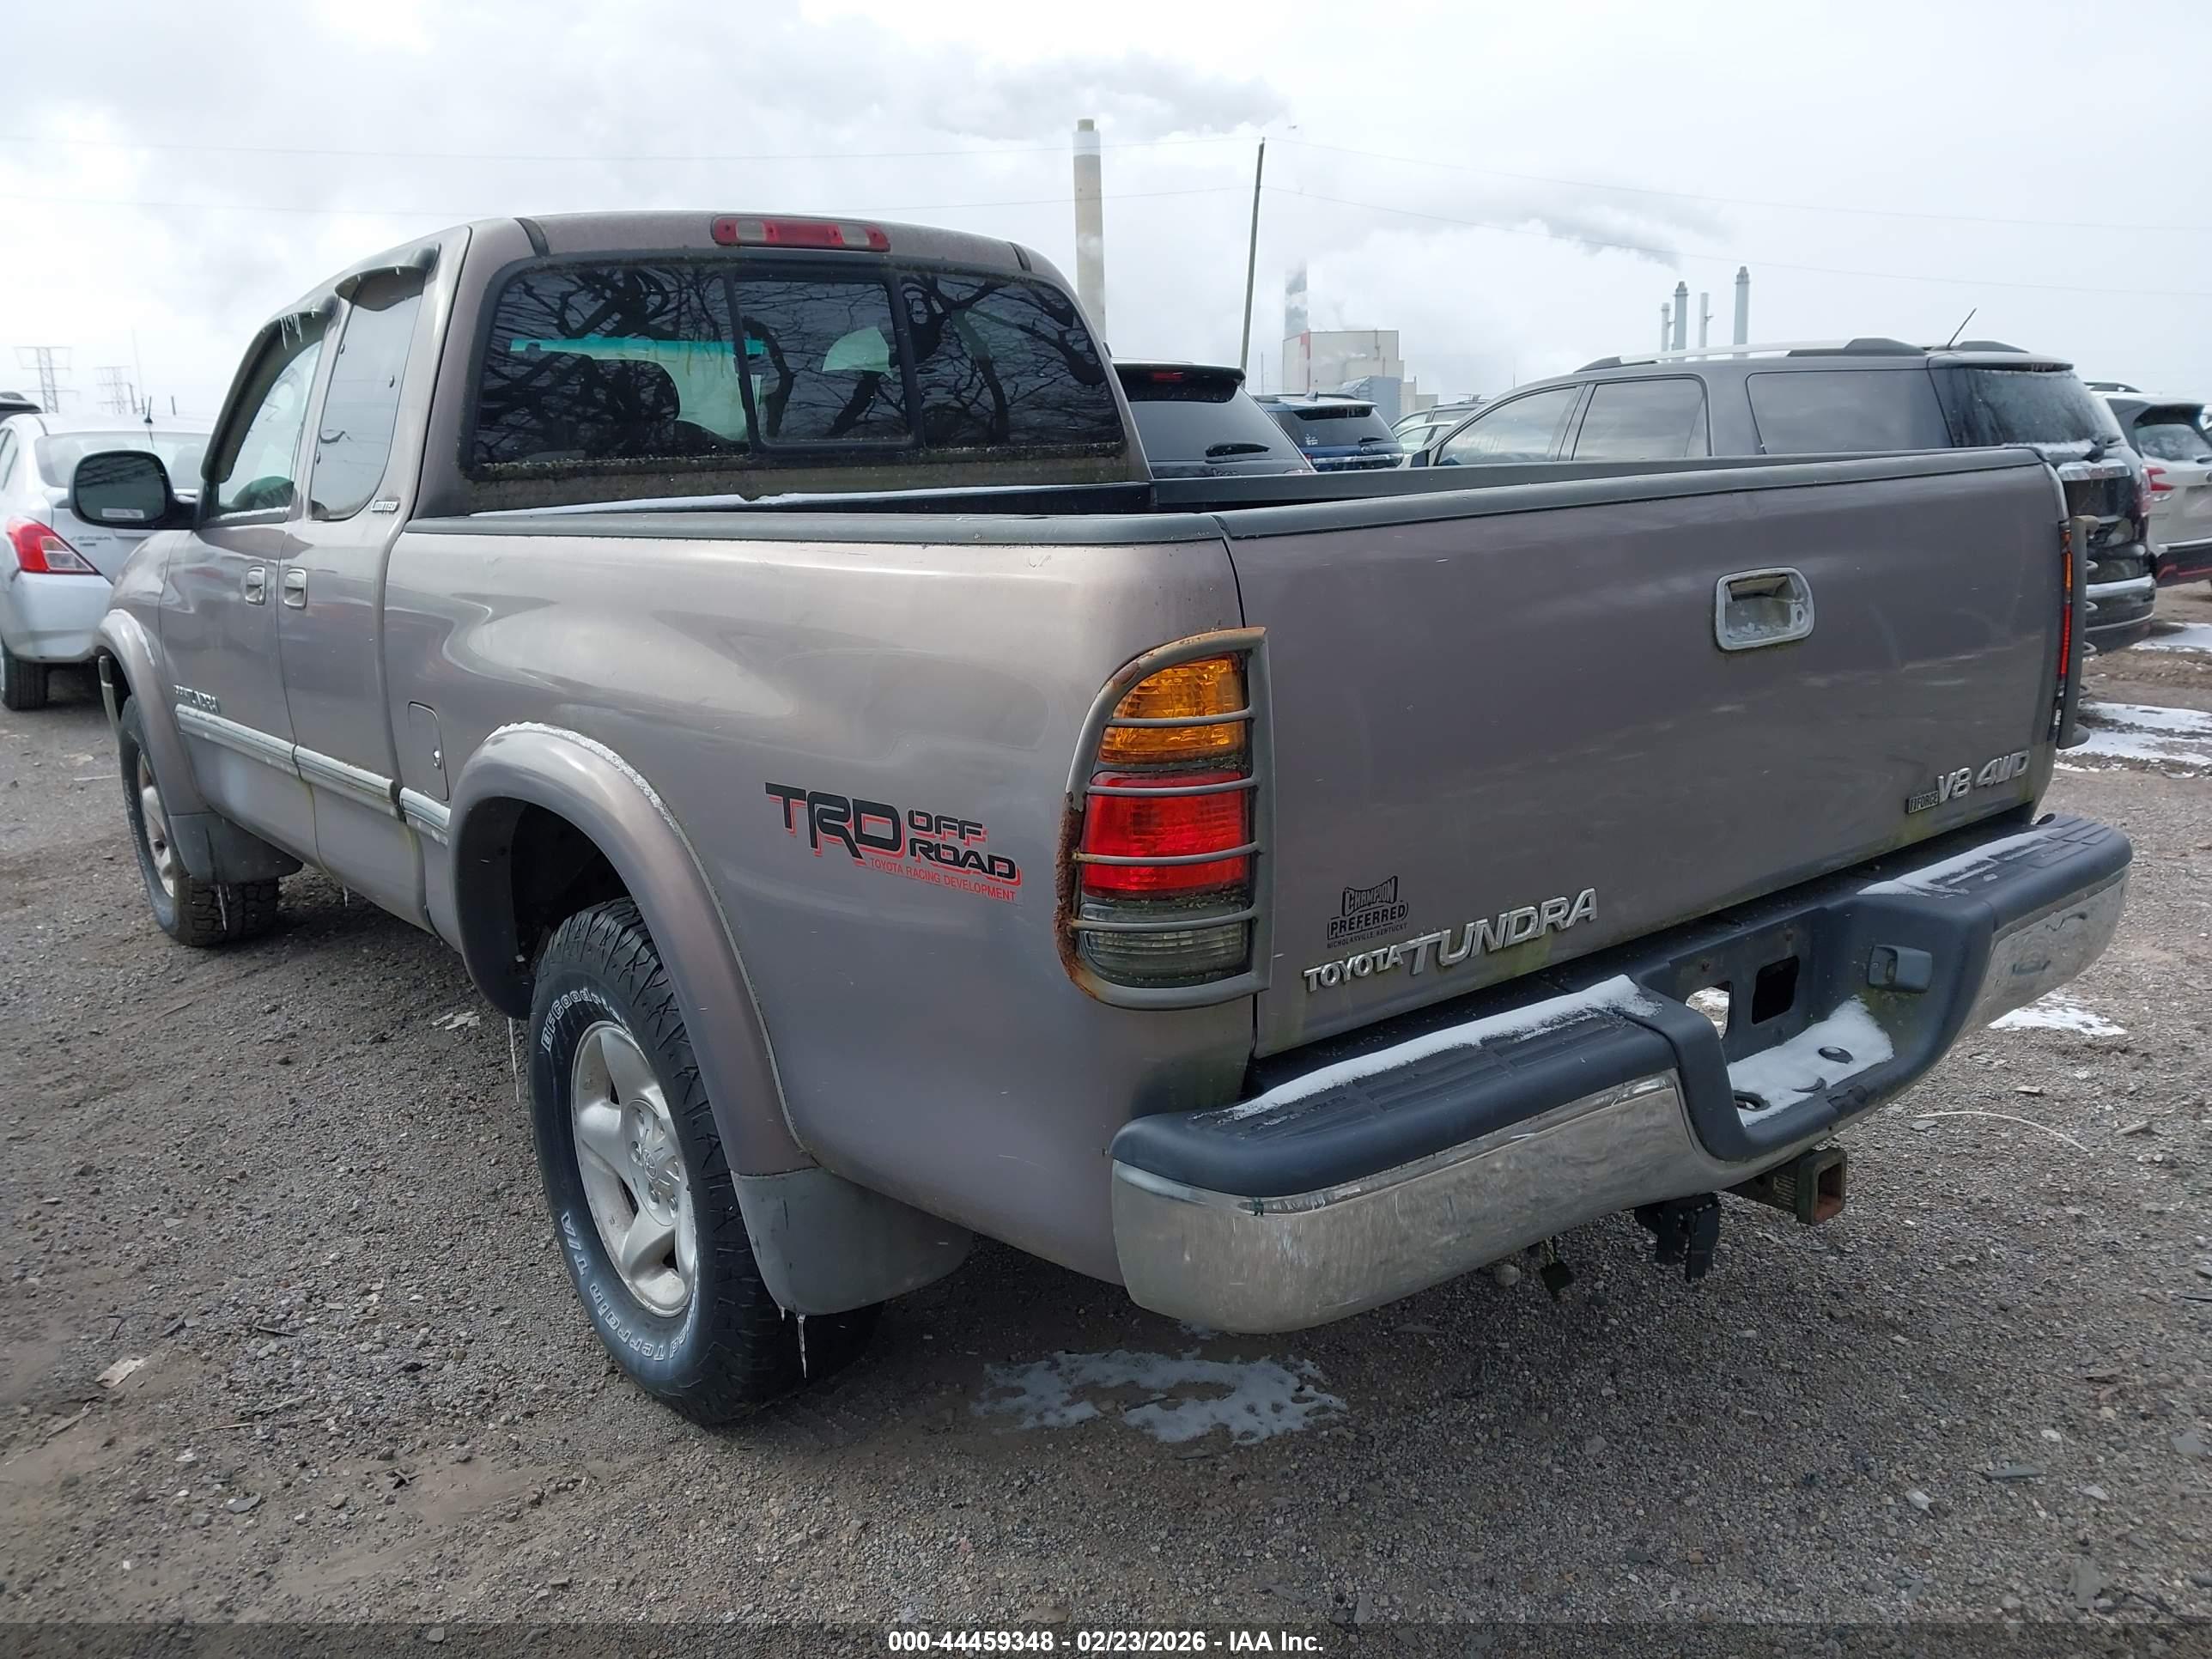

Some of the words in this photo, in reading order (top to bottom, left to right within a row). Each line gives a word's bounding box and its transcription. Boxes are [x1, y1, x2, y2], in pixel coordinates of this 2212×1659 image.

[1937, 767, 1972, 804] V8
[1975, 750, 2030, 787] 4WD
[765, 782, 905, 866] TRD
[908, 809, 987, 846] OFF
[871, 859, 903, 873] TOYOTA
[907, 866, 941, 884] RACING
[945, 875, 1016, 901] DEVELOPMENT
[908, 837, 1021, 886] ROAD
[1330, 905, 1407, 935] PREFERRED
[1343, 876, 1398, 916] CHAMPION
[1304, 945, 1403, 993] TOYOTA
[1398, 888, 1597, 975] TUNDRA
[561, 1211, 589, 1276] T/A
